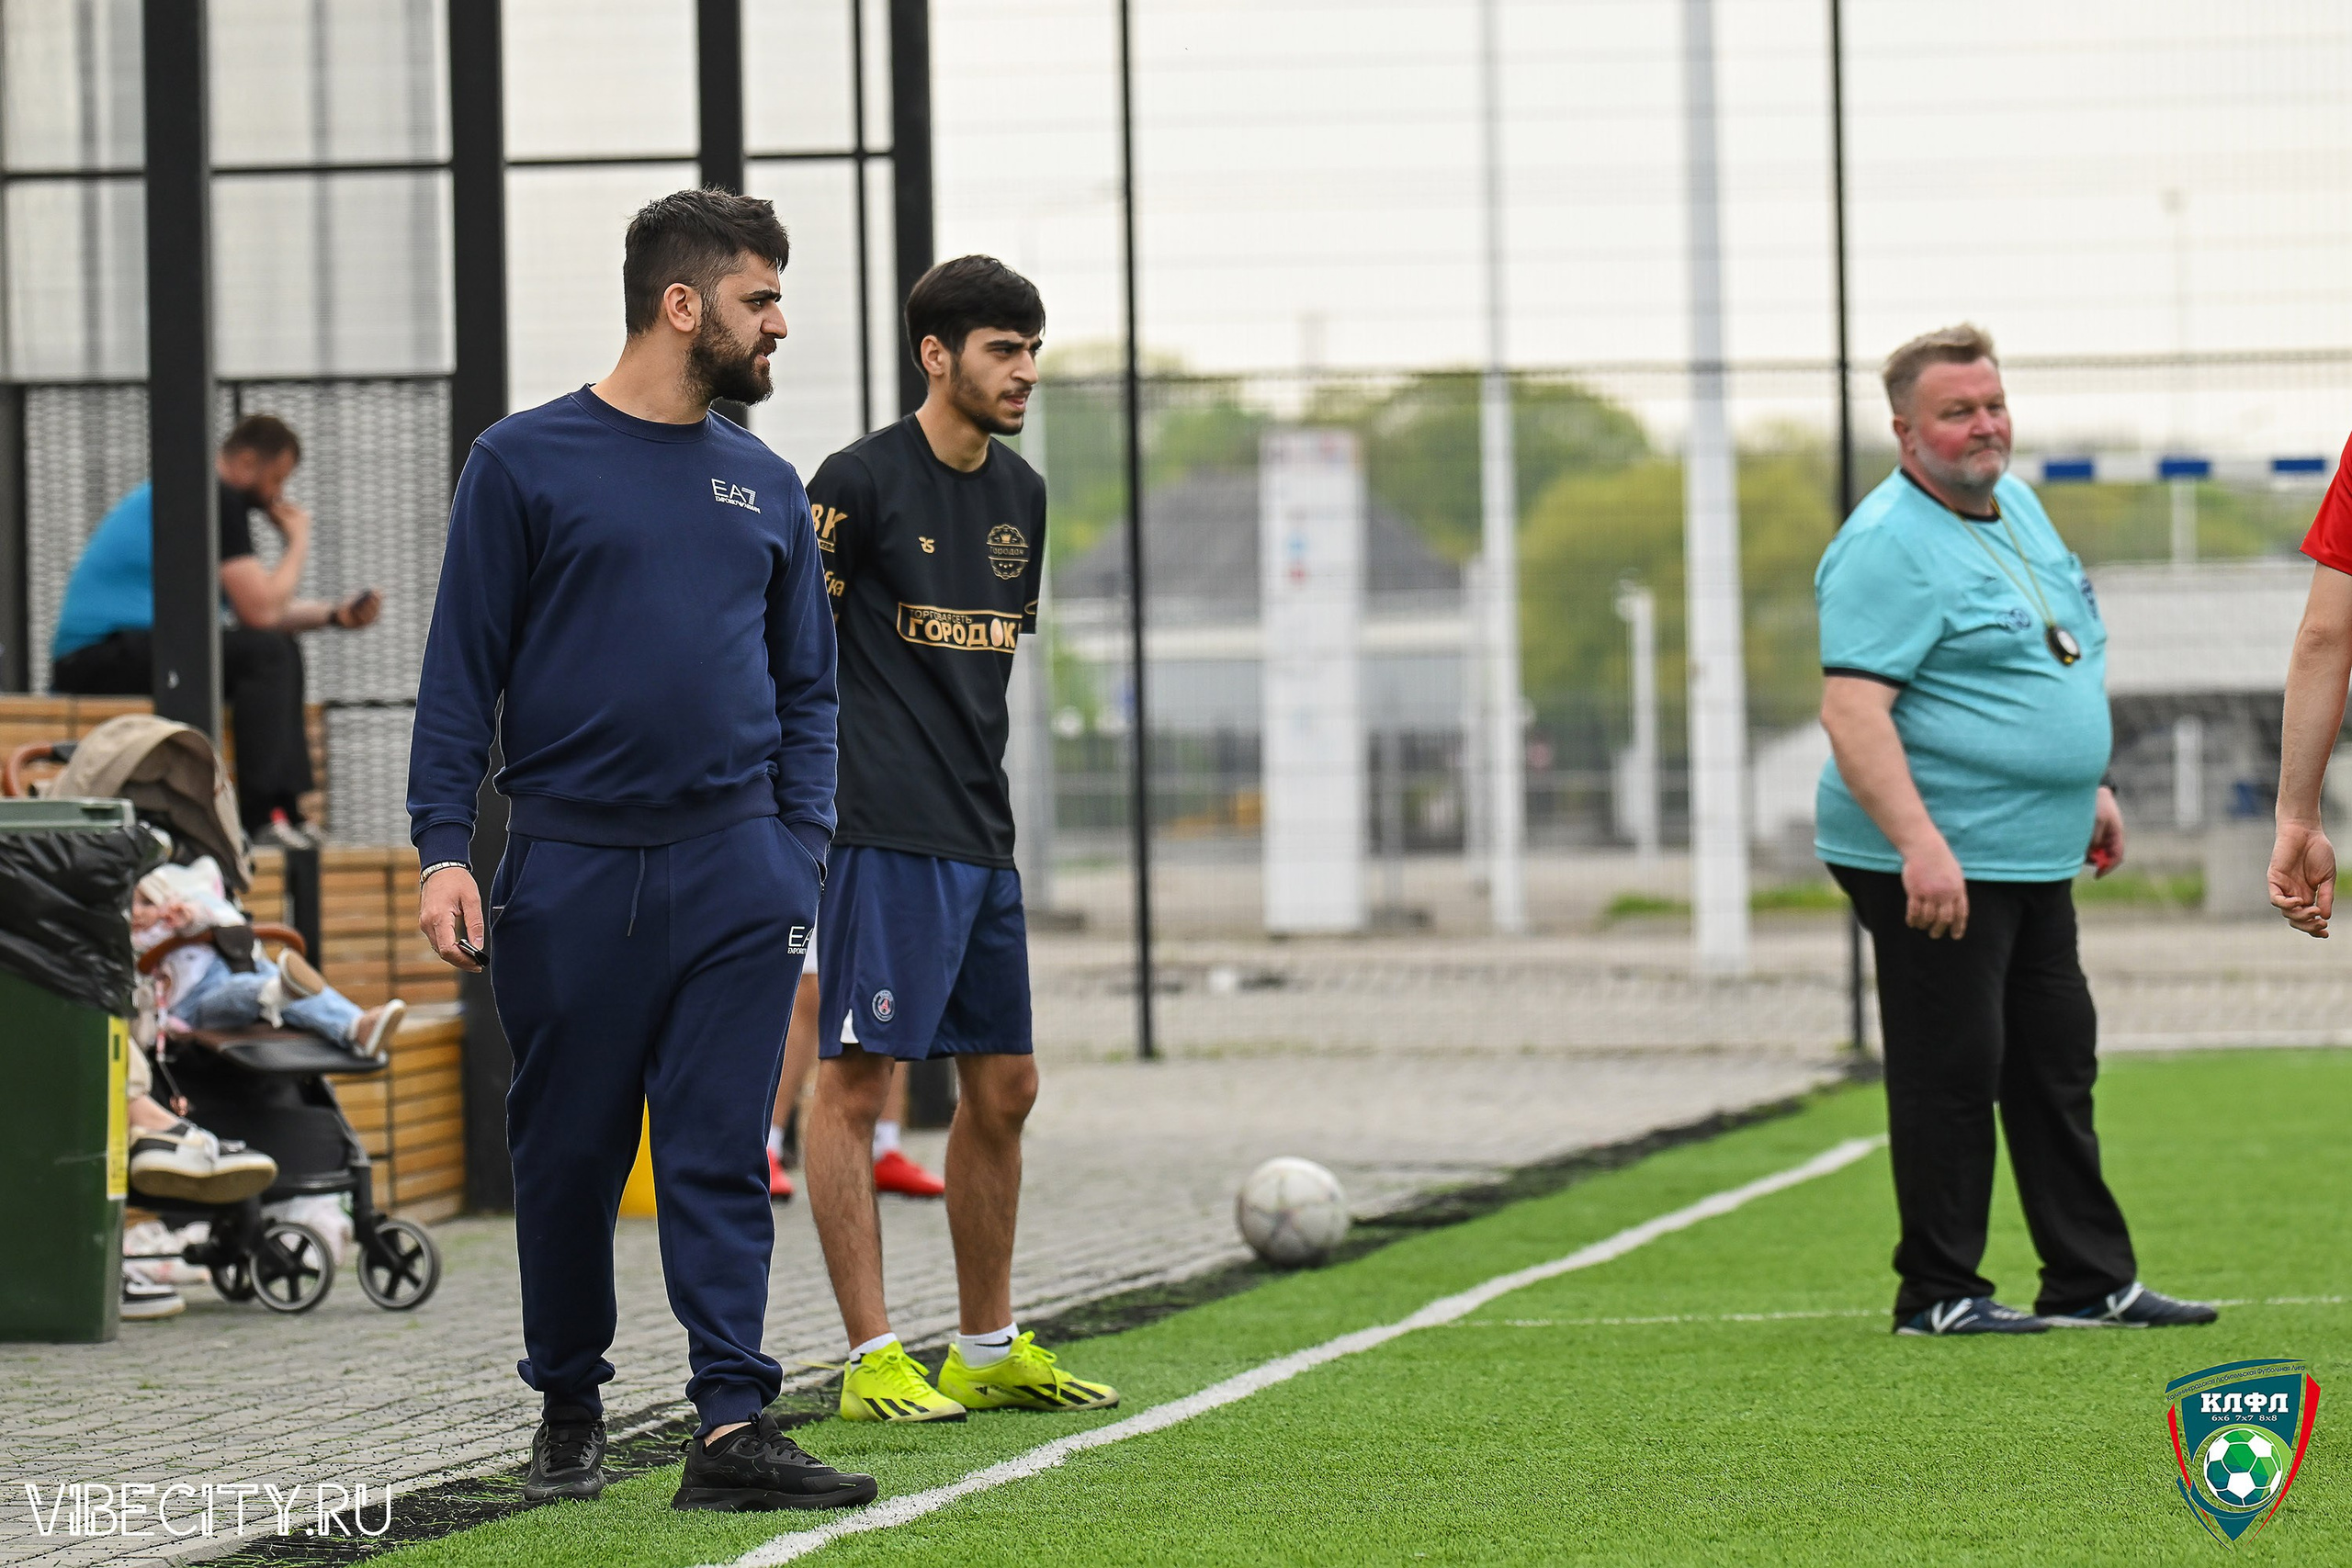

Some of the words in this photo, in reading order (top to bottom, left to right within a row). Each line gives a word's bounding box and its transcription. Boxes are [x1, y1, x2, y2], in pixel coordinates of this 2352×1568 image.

[711, 478, 756, 505] EA7
[908, 617, 1016, 649] ГОРОДОК
[952, 615, 973, 625] СЕТЬ
